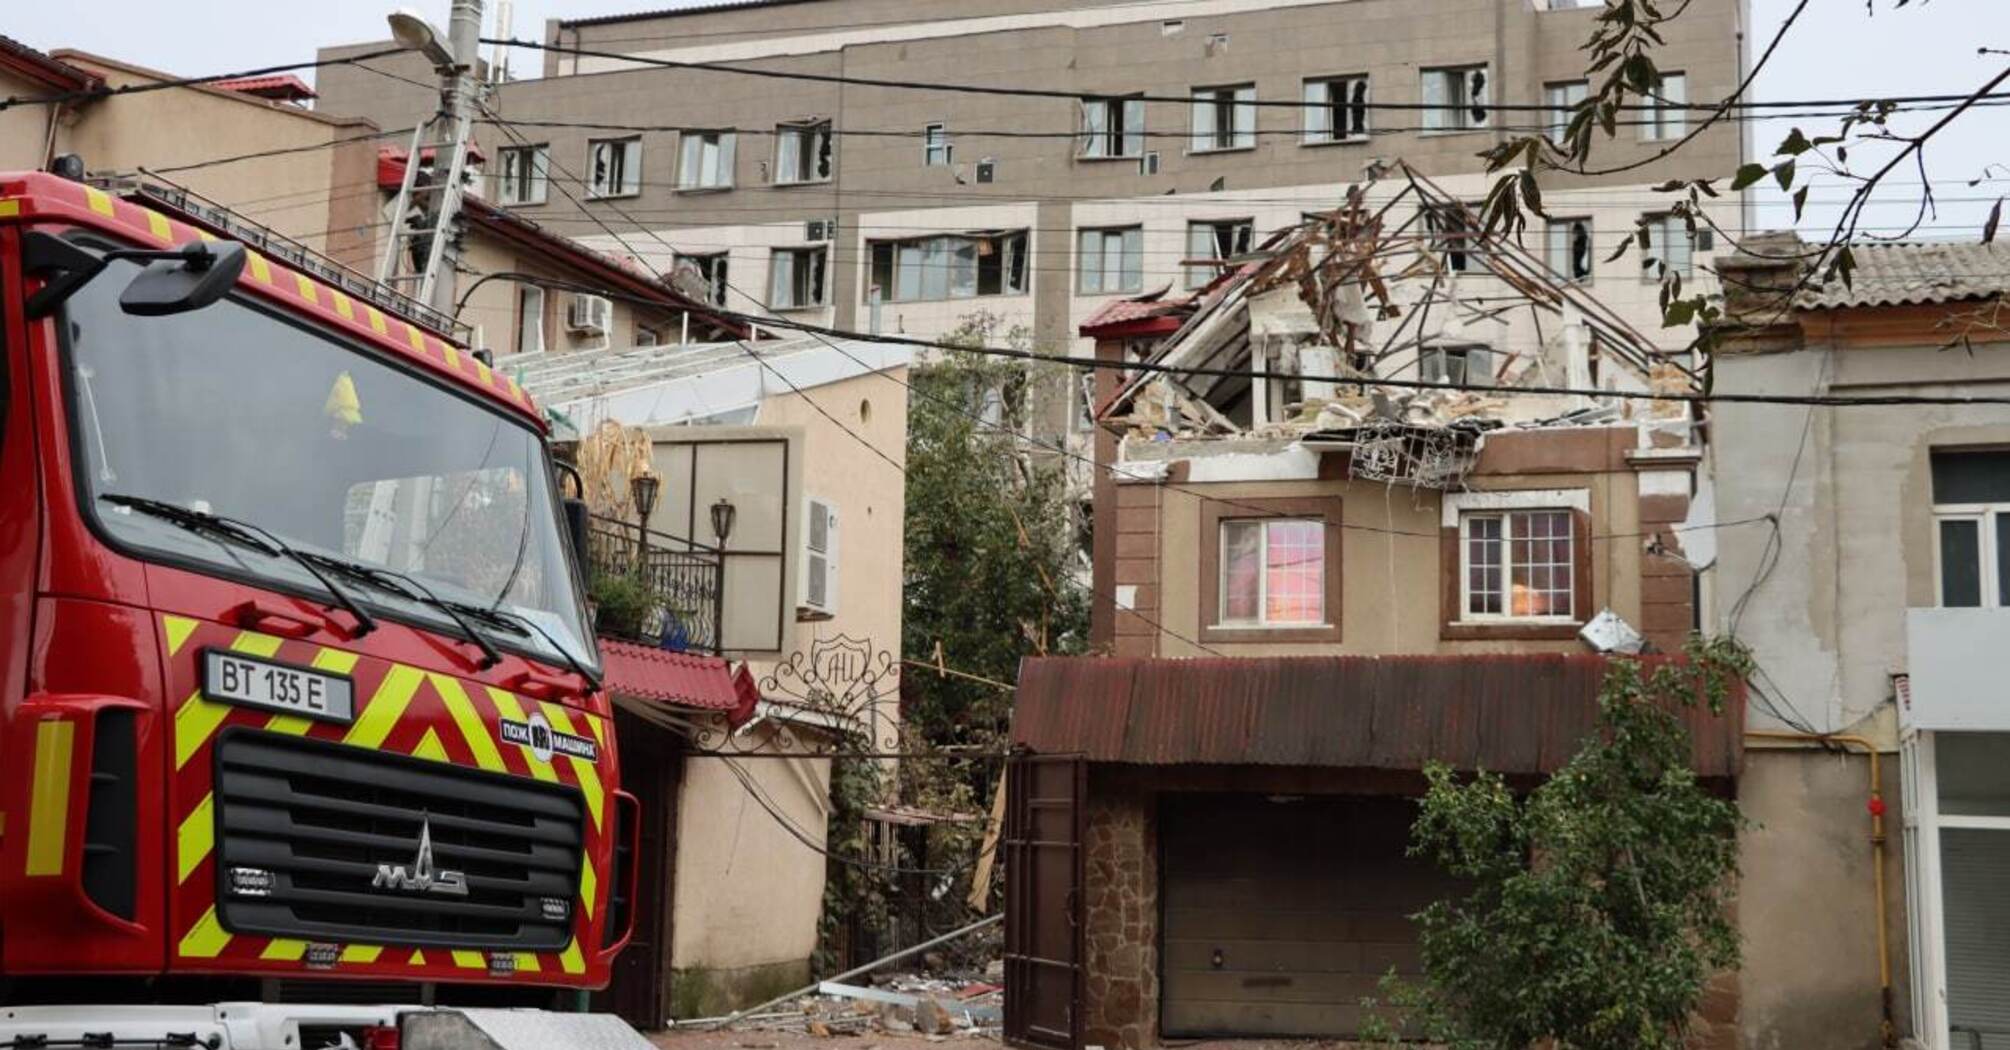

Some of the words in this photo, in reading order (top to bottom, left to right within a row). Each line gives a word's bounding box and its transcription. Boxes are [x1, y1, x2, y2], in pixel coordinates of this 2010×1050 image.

[222, 659, 256, 696] BT
[264, 669, 301, 705] 135
[307, 676, 323, 710] E
[503, 722, 529, 742] ПОЖ
[552, 734, 596, 758] МАШИНА
